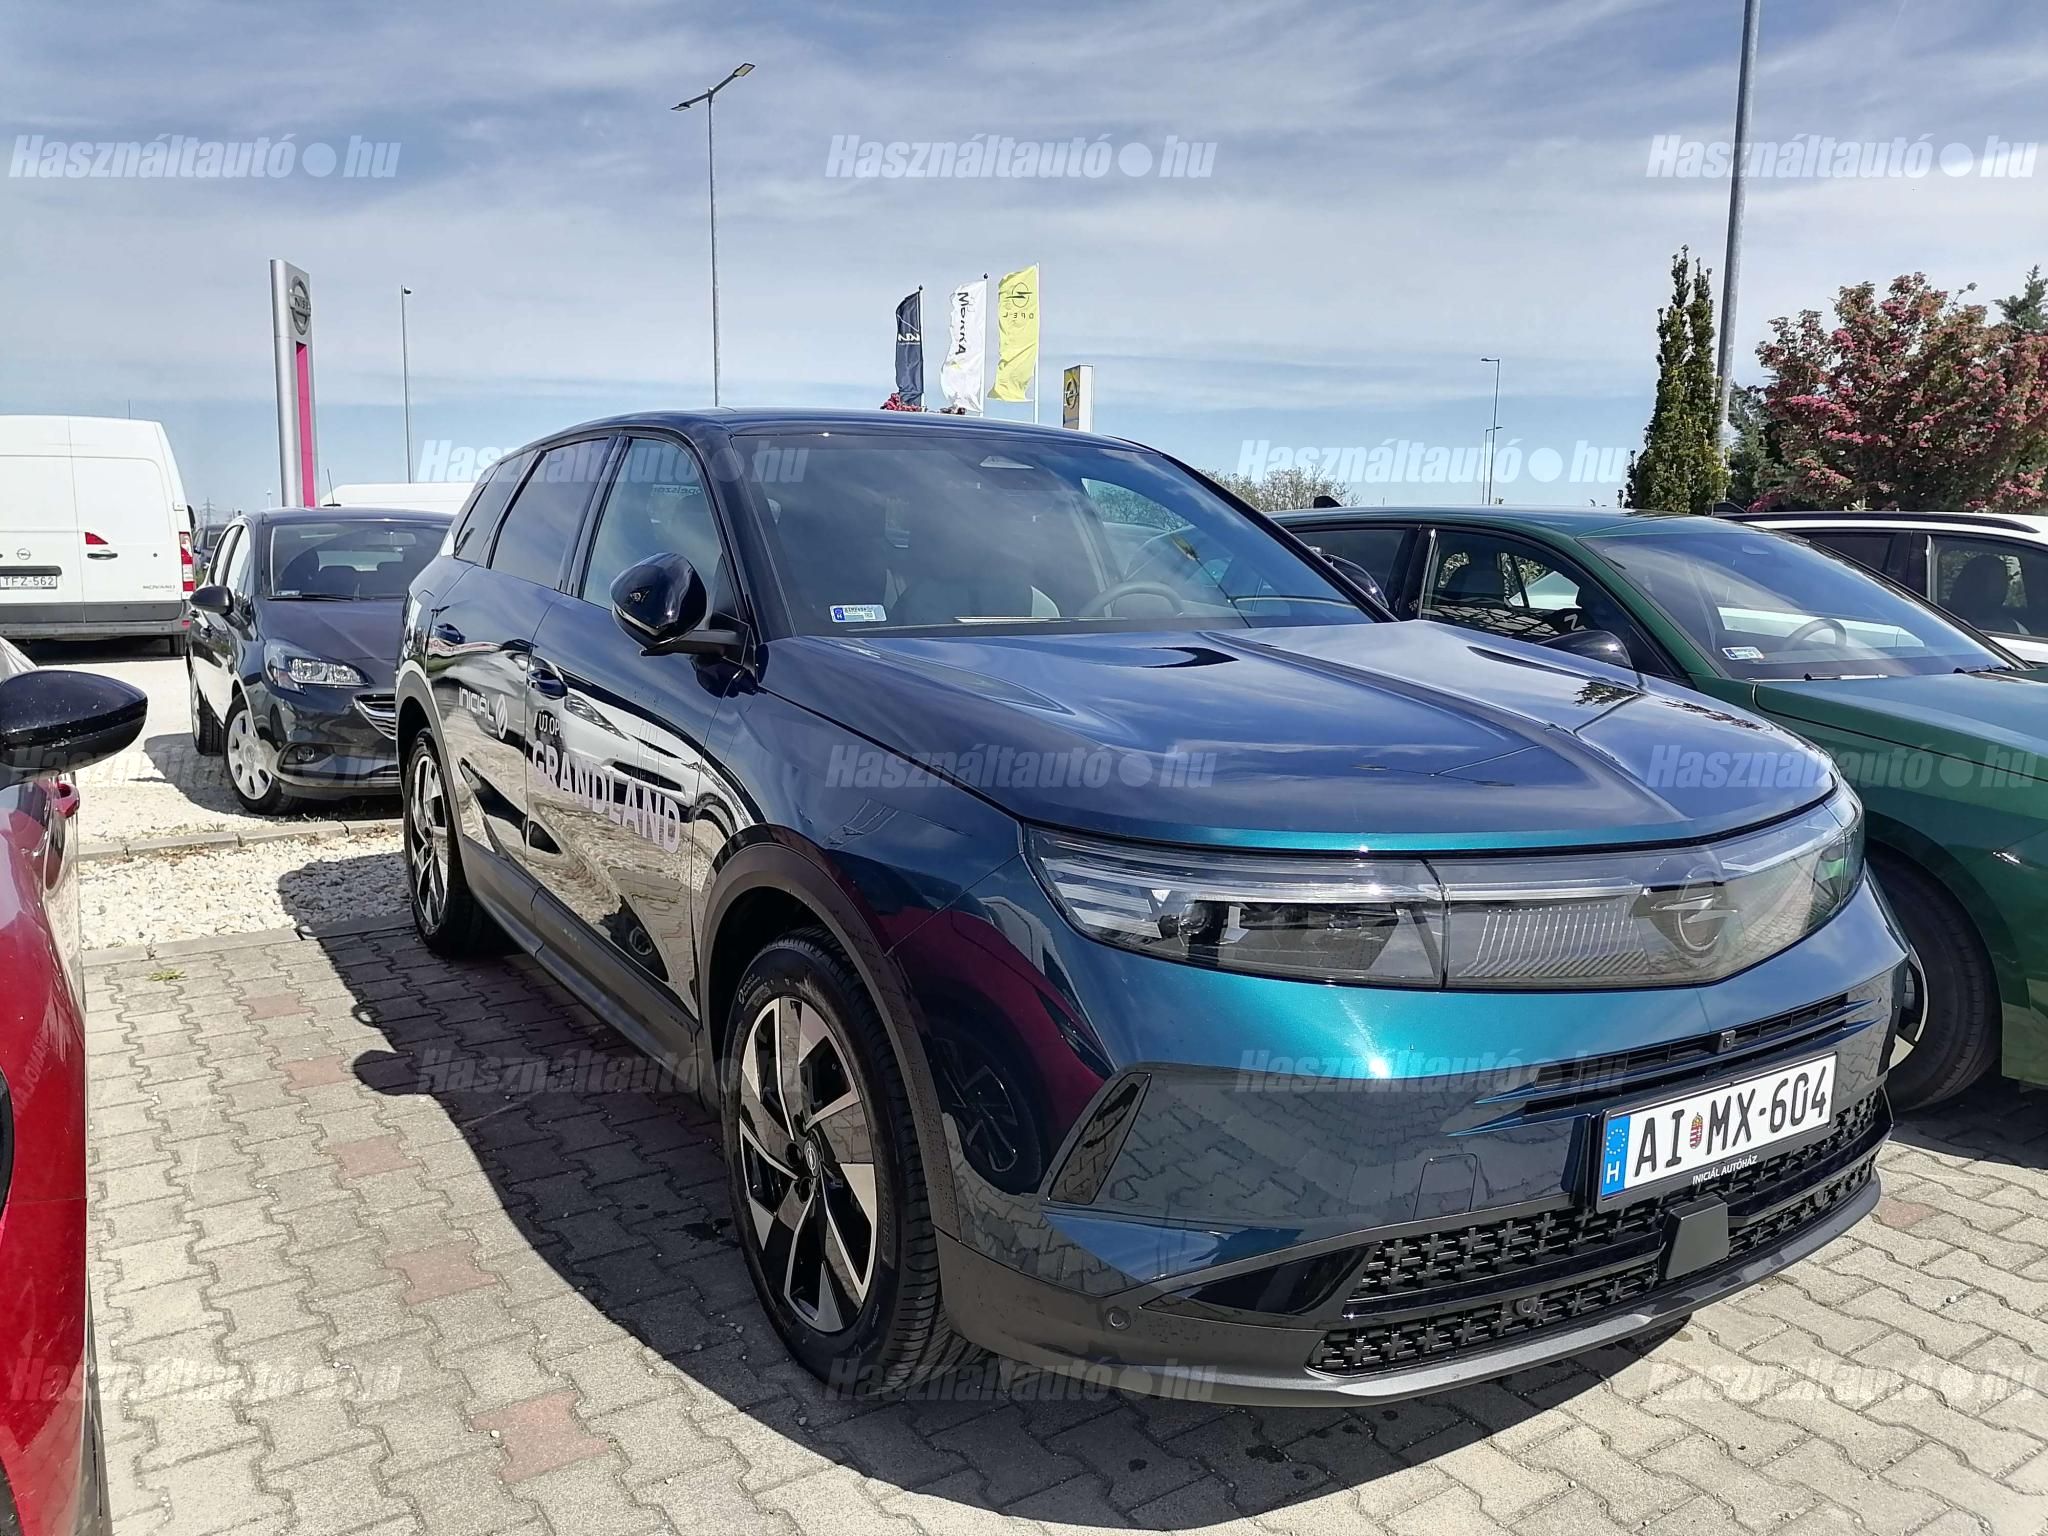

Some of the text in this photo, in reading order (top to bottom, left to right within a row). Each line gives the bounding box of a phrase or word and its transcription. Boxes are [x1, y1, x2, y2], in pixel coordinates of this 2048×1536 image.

[458, 686, 495, 722] INICIÁL
[533, 741, 681, 855] GRANDLAND
[1634, 1066, 1828, 1178] AI MX-604
[1605, 1160, 1620, 1185] H
[1692, 1154, 1759, 1185] INICIÁL AUTÓHÁZ
